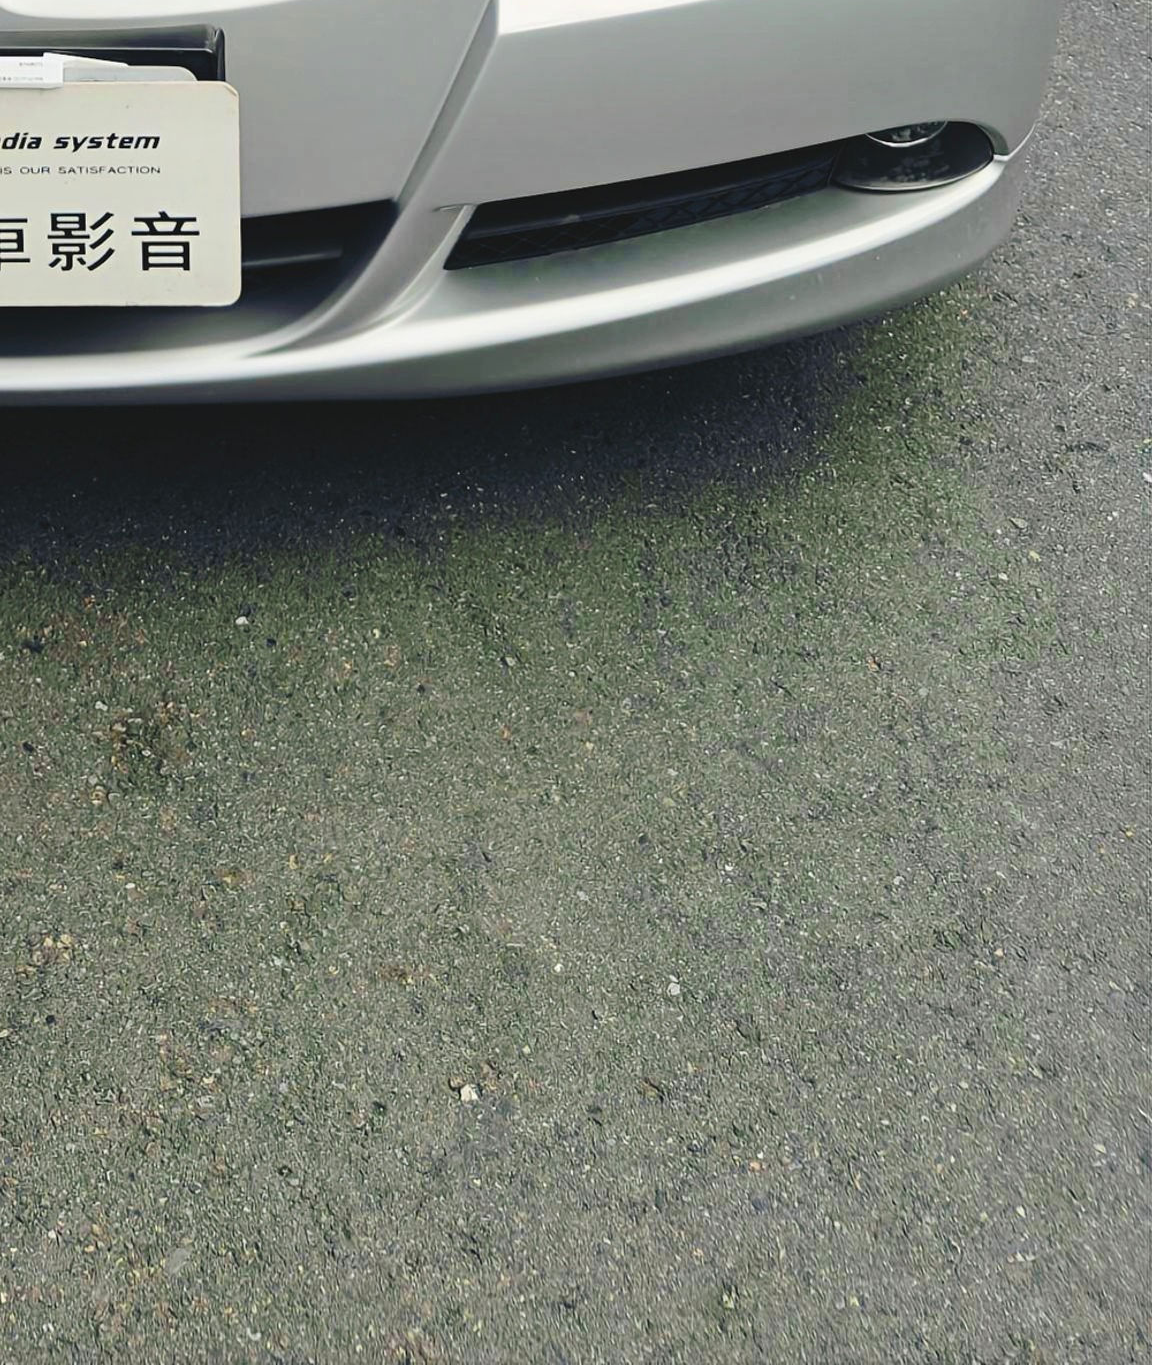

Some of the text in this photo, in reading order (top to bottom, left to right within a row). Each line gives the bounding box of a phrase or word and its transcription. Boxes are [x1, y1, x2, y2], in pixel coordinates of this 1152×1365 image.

[53, 132, 161, 153] system
[0, 166, 12, 175] IS
[19, 166, 51, 175] OUR
[58, 165, 161, 175] SATISFACTION
